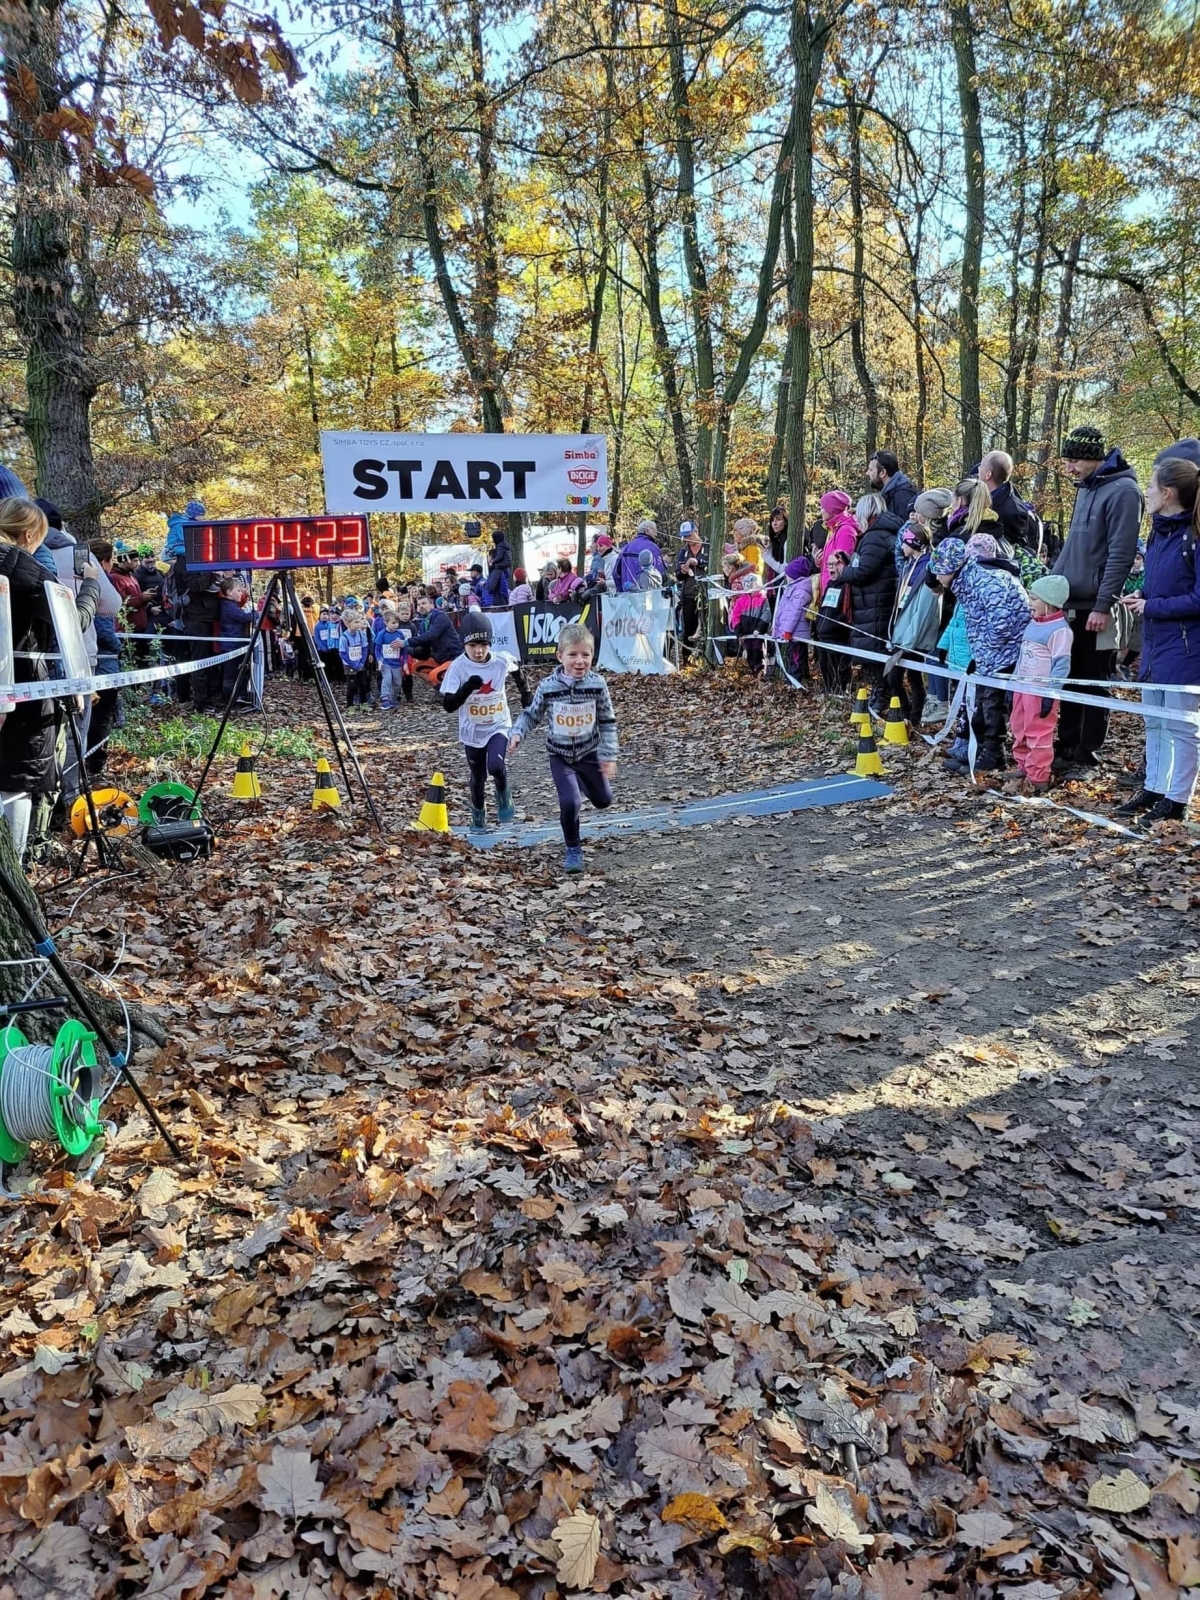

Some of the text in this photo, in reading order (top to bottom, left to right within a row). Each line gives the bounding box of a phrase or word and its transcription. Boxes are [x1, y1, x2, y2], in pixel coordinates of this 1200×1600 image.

[564, 450, 596, 459] Simba
[353, 458, 536, 500] START
[566, 493, 602, 508] Smoby
[208, 521, 362, 561] 11:04:23
[469, 701, 503, 716] 6054
[556, 712, 593, 727] 6053
